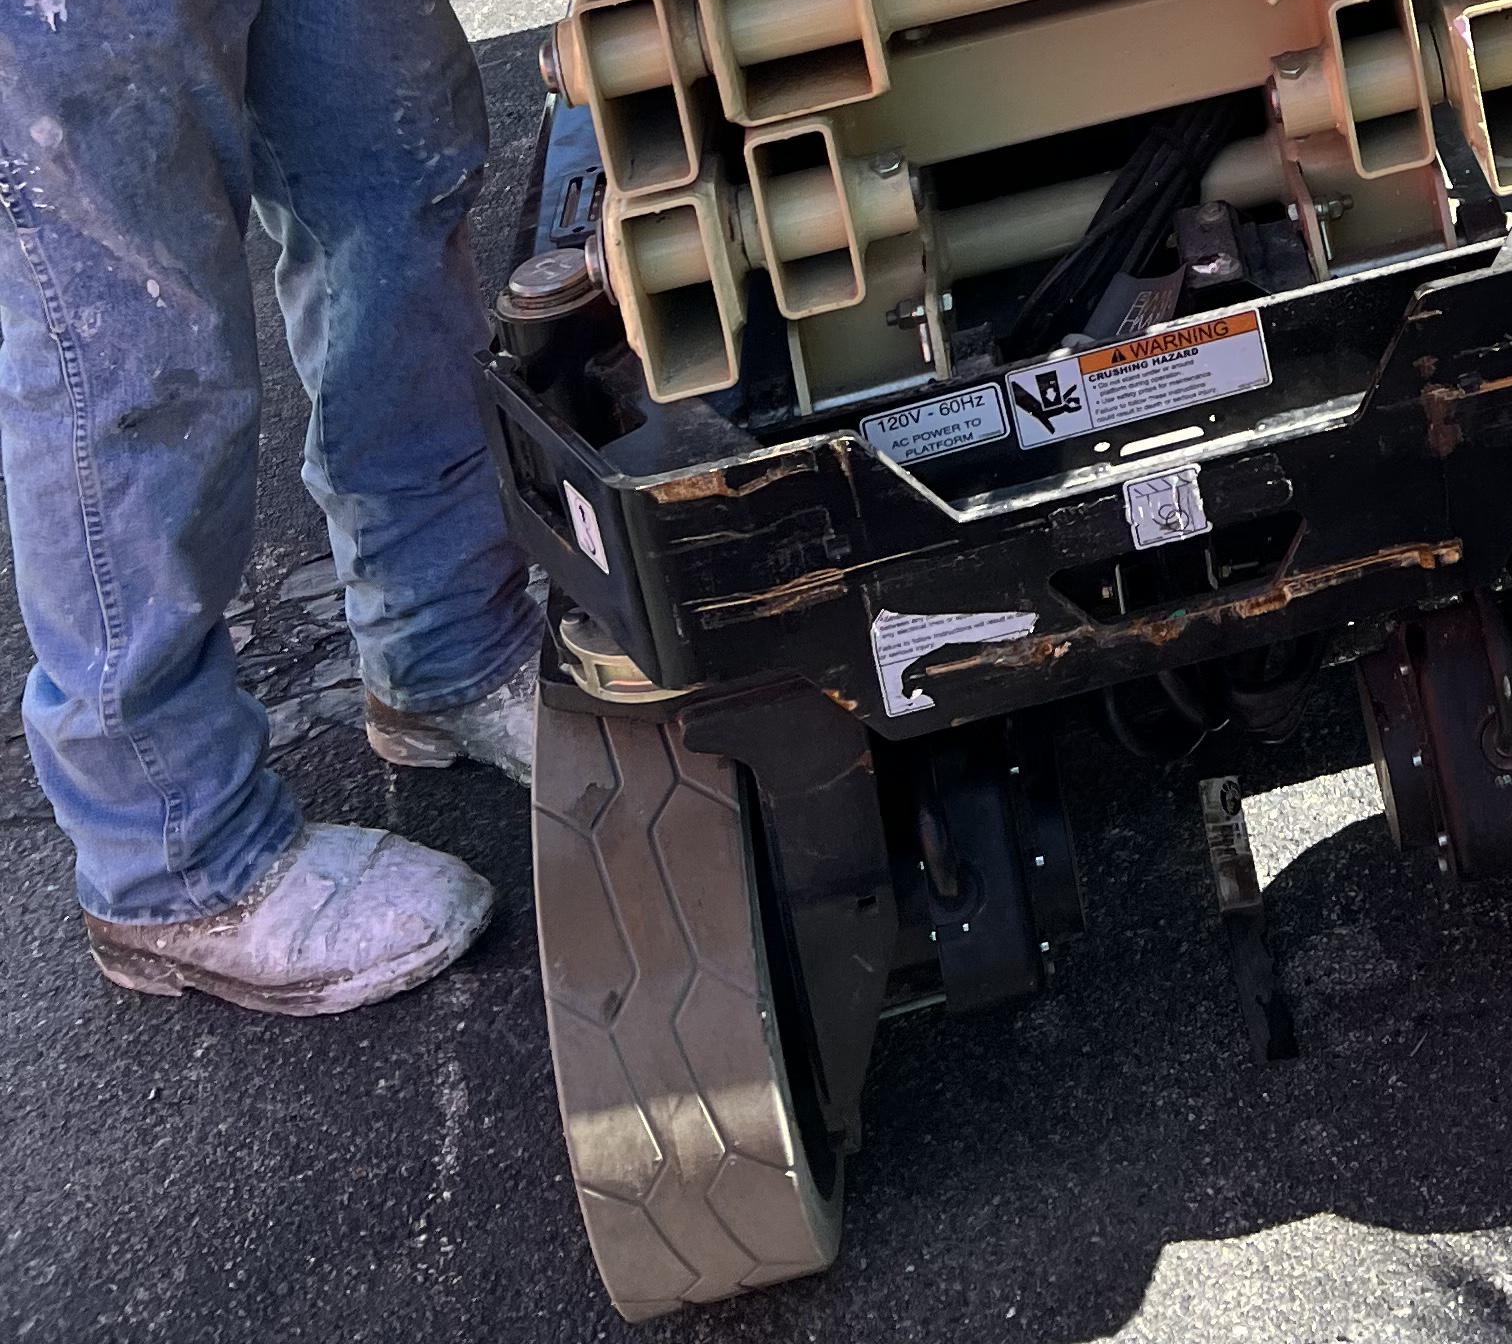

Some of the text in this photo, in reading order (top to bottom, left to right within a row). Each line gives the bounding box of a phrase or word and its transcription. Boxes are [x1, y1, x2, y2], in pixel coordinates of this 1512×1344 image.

[1129, 321, 1229, 359] WARNING
[1088, 347, 1199, 383] CRUSHING HAZARD
[878, 409, 921, 432] 120V
[939, 395, 985, 416] 60Hz
[892, 418, 982, 450] AC POWER TO
[905, 432, 974, 459] PLATFORM
